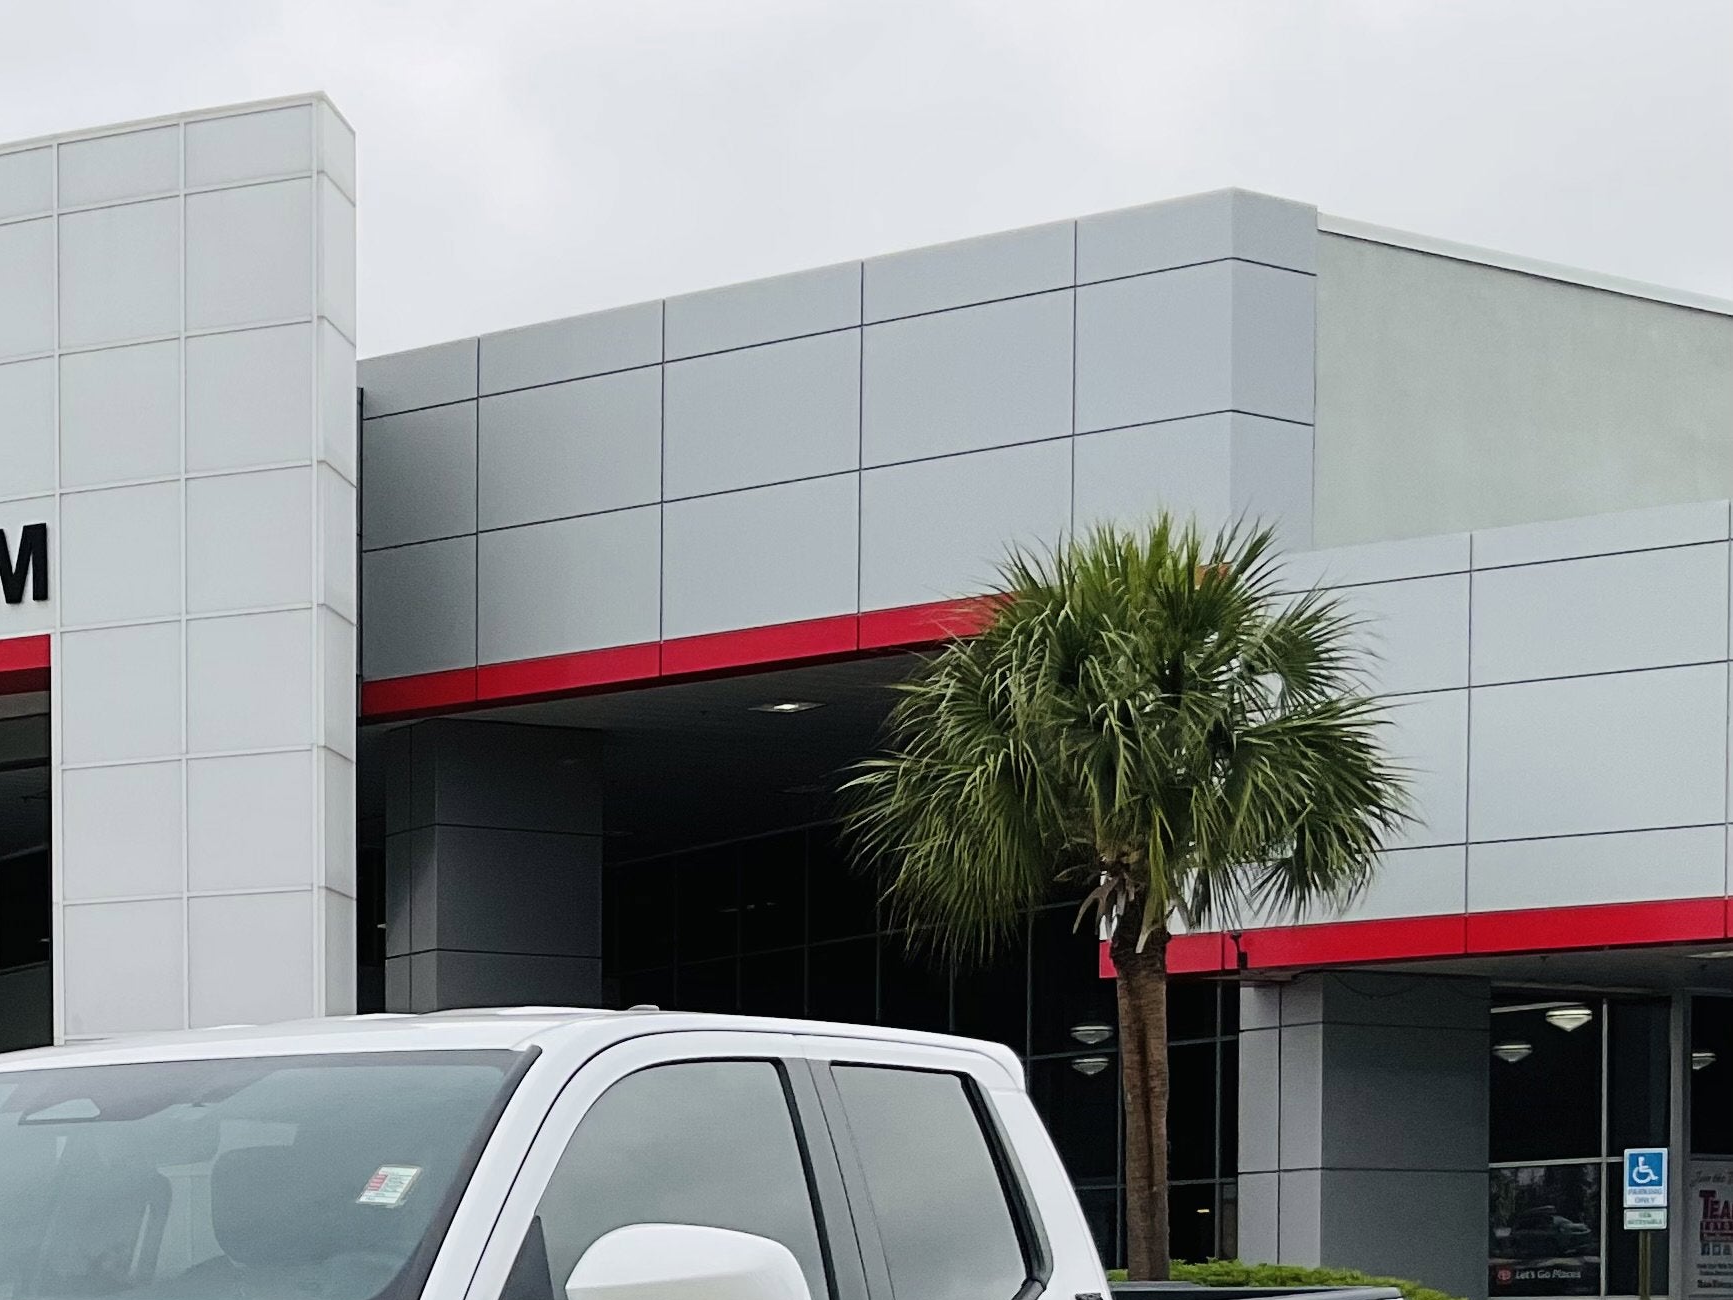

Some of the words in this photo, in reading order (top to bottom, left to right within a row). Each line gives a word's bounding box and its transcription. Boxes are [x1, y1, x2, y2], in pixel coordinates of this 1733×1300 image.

[1699, 1189, 1733, 1219] TEA
[1515, 1270, 1535, 1280] Let's
[1537, 1270, 1551, 1279] Go
